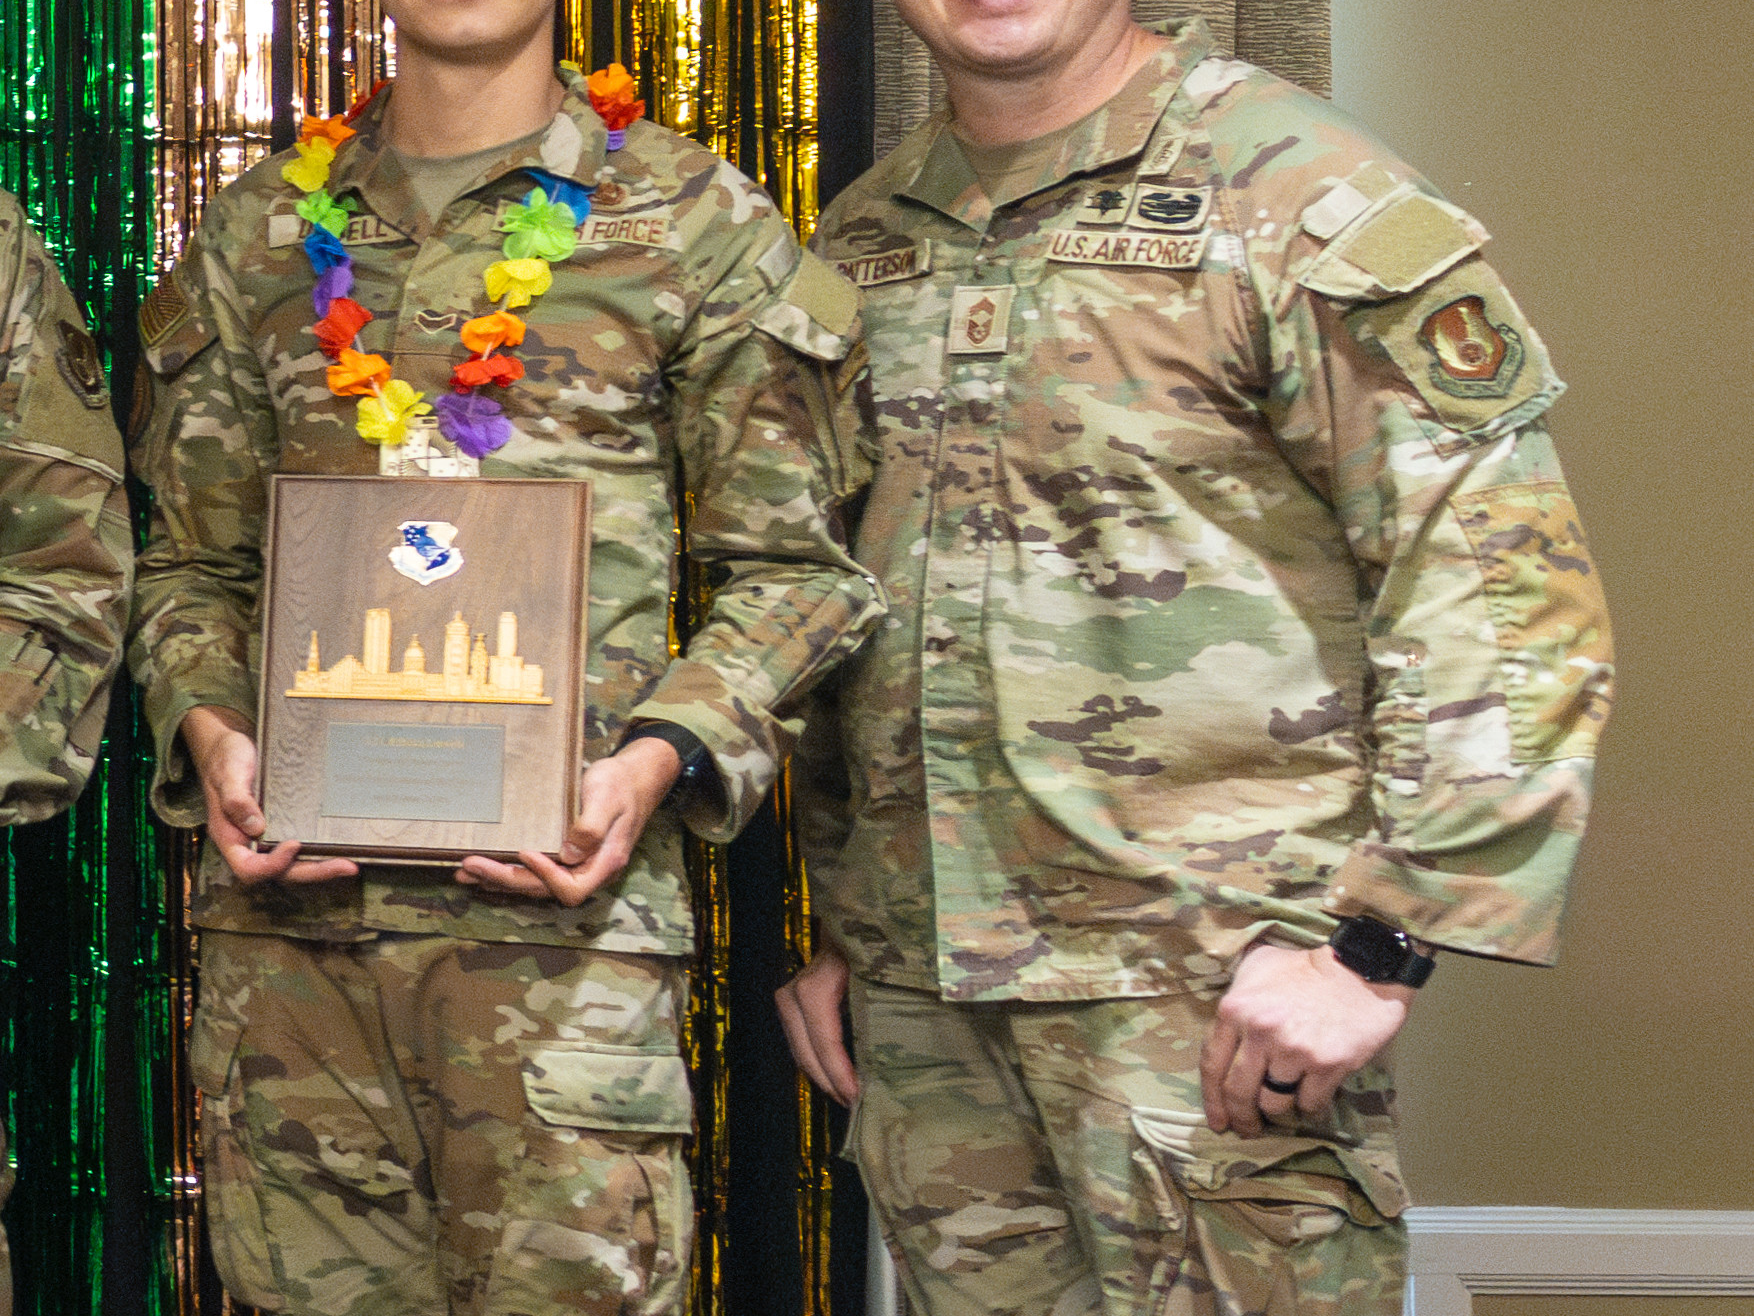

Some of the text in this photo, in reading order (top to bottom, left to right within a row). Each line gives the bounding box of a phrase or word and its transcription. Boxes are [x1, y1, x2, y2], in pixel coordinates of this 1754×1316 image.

[592, 219, 664, 243] FORCE
[1052, 233, 1201, 265] U.S. AIR FORCE
